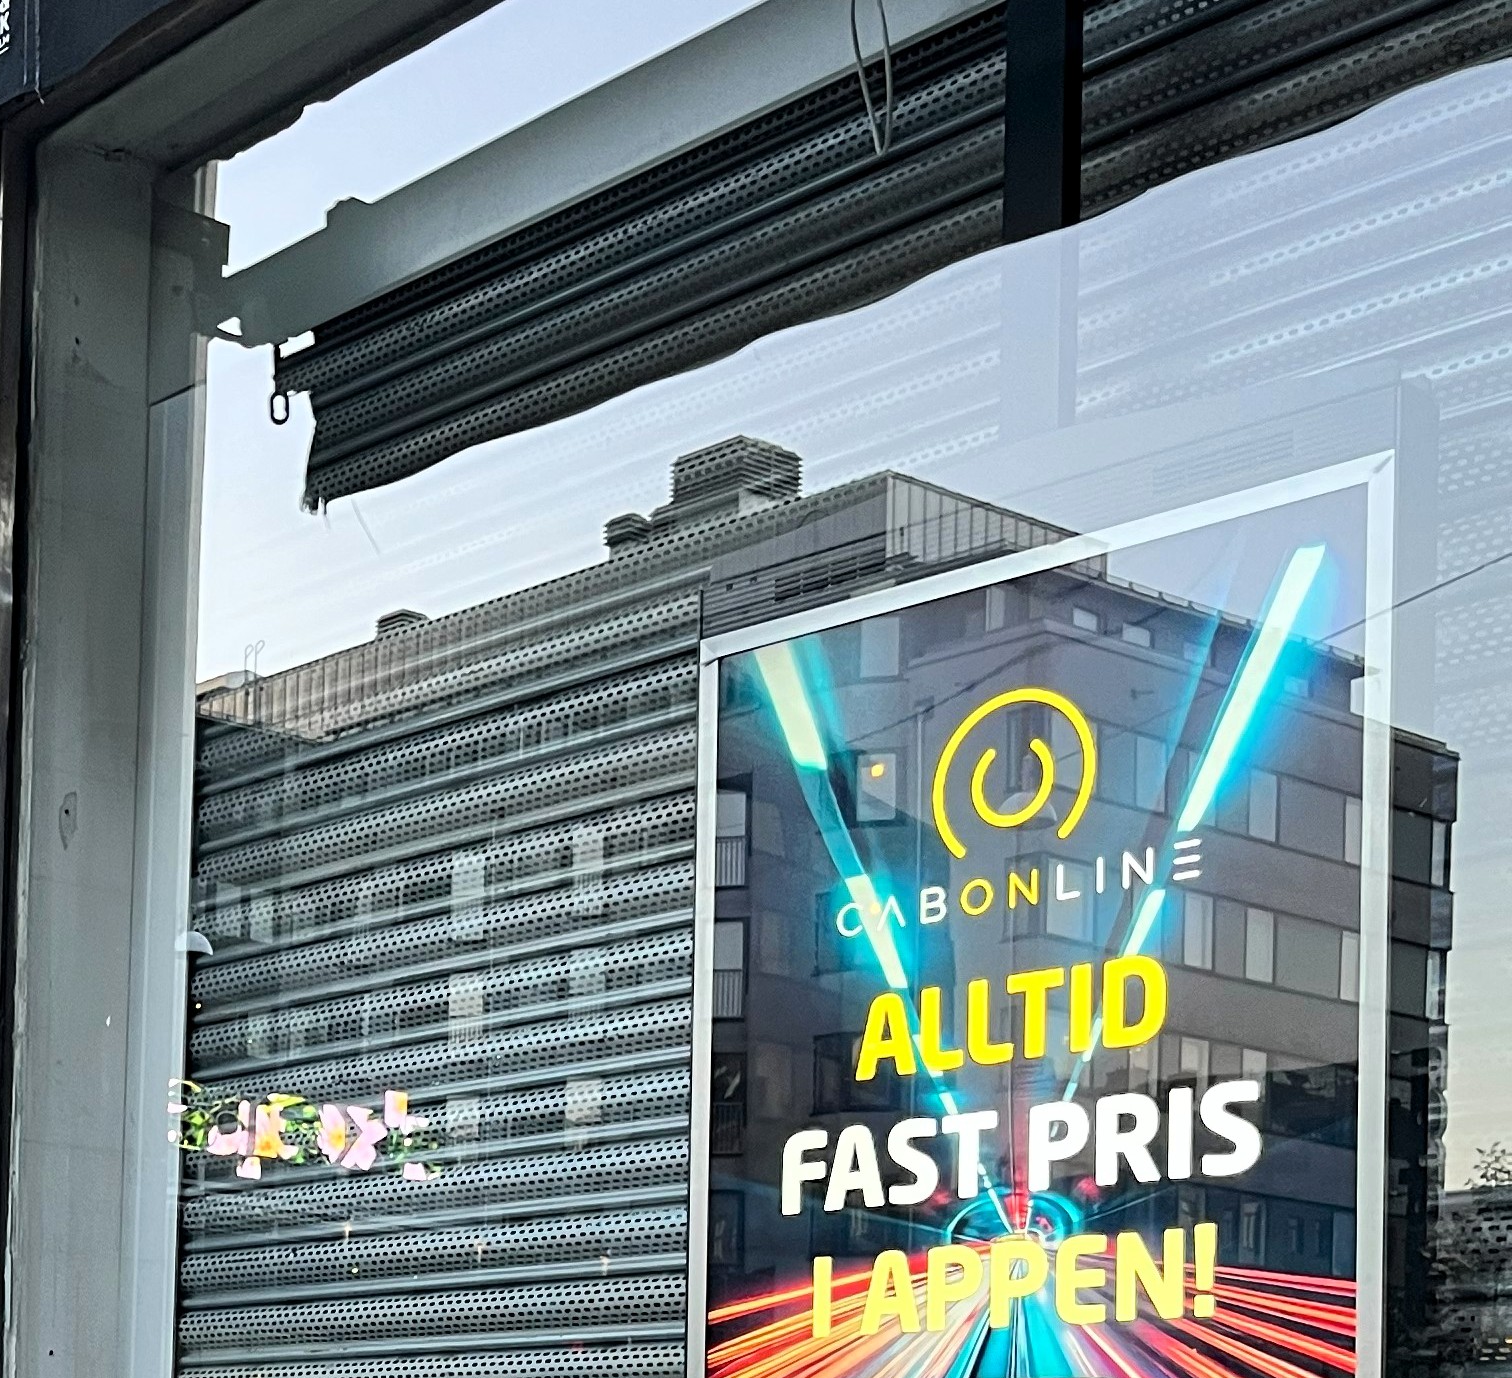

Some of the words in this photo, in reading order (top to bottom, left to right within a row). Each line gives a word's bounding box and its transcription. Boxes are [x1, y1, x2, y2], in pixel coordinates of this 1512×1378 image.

[837, 837, 1202, 938] CABONLINE
[855, 955, 1169, 1082] ALLTID
[781, 1108, 999, 1217] FAST
[1028, 1080, 1262, 1192] PRIS
[811, 1255, 832, 1339] I
[859, 1222, 1219, 1336] APPEN!
